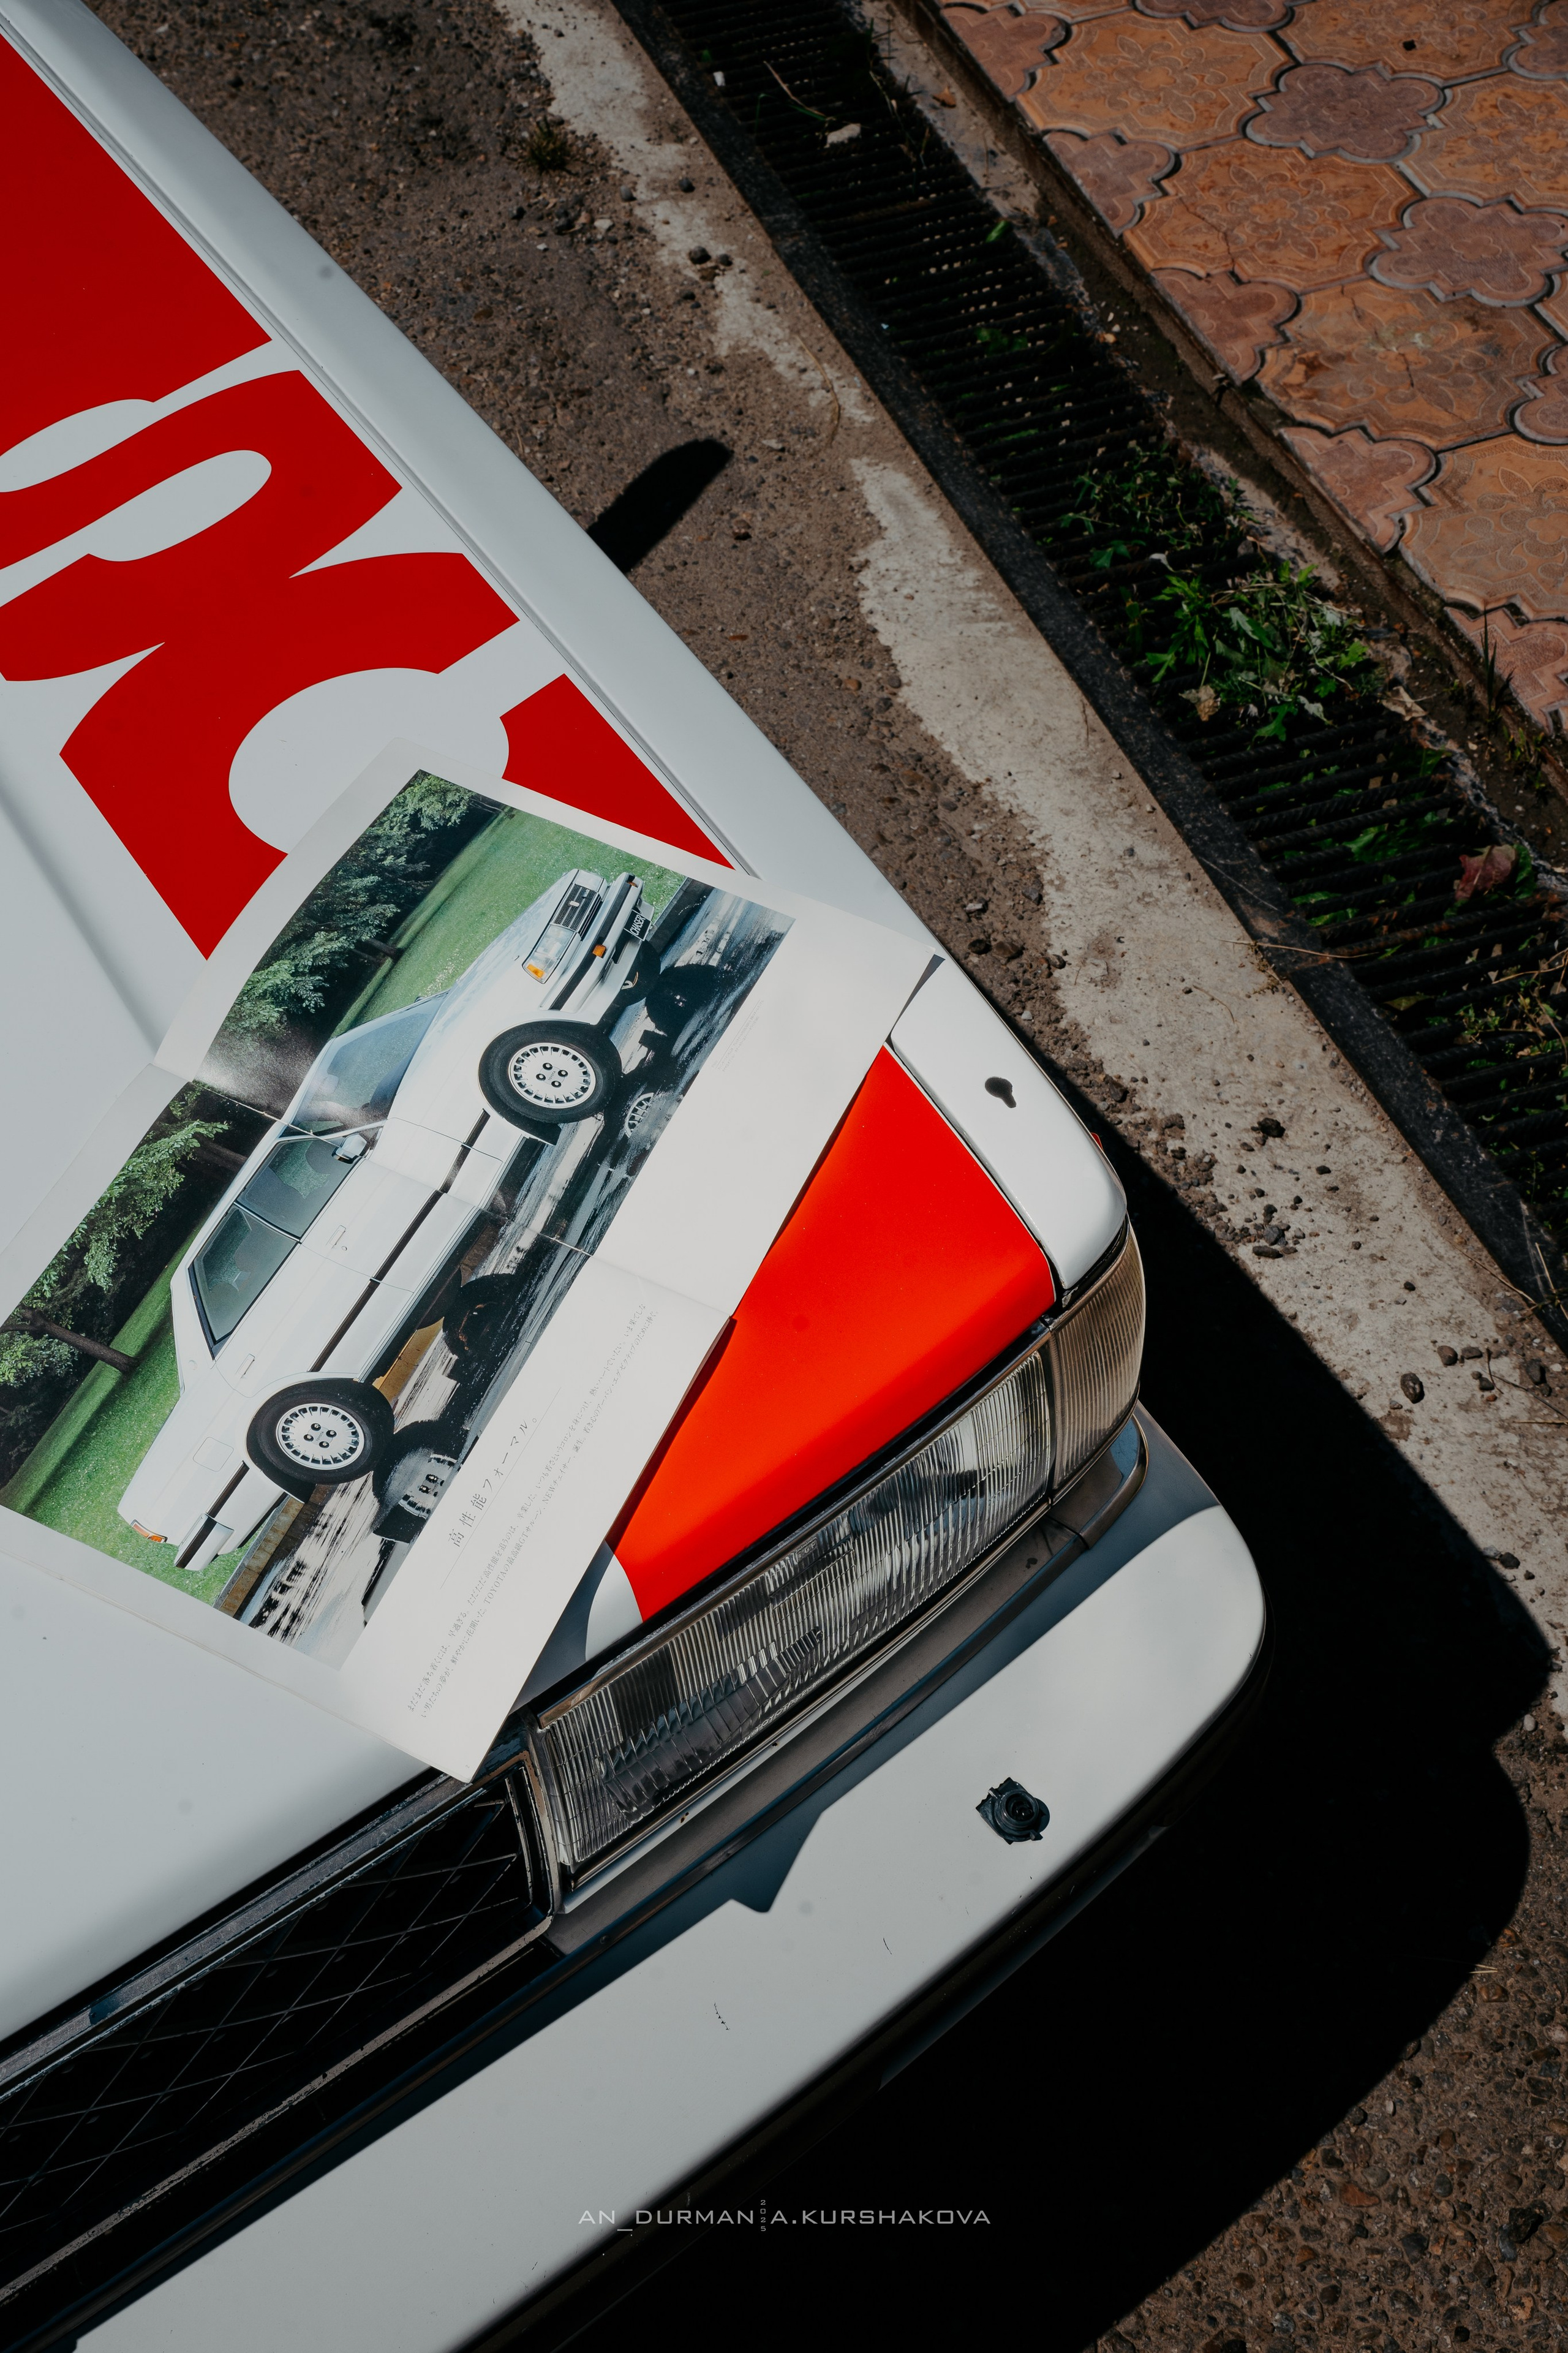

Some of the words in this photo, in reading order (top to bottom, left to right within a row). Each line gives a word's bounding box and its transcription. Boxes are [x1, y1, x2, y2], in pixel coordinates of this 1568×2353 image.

[630, 915, 645, 937] CHASER
[448, 1418, 537, 1547] 高性能フォーマル。
[758, 1699, 796, 1729] TOYOTA
